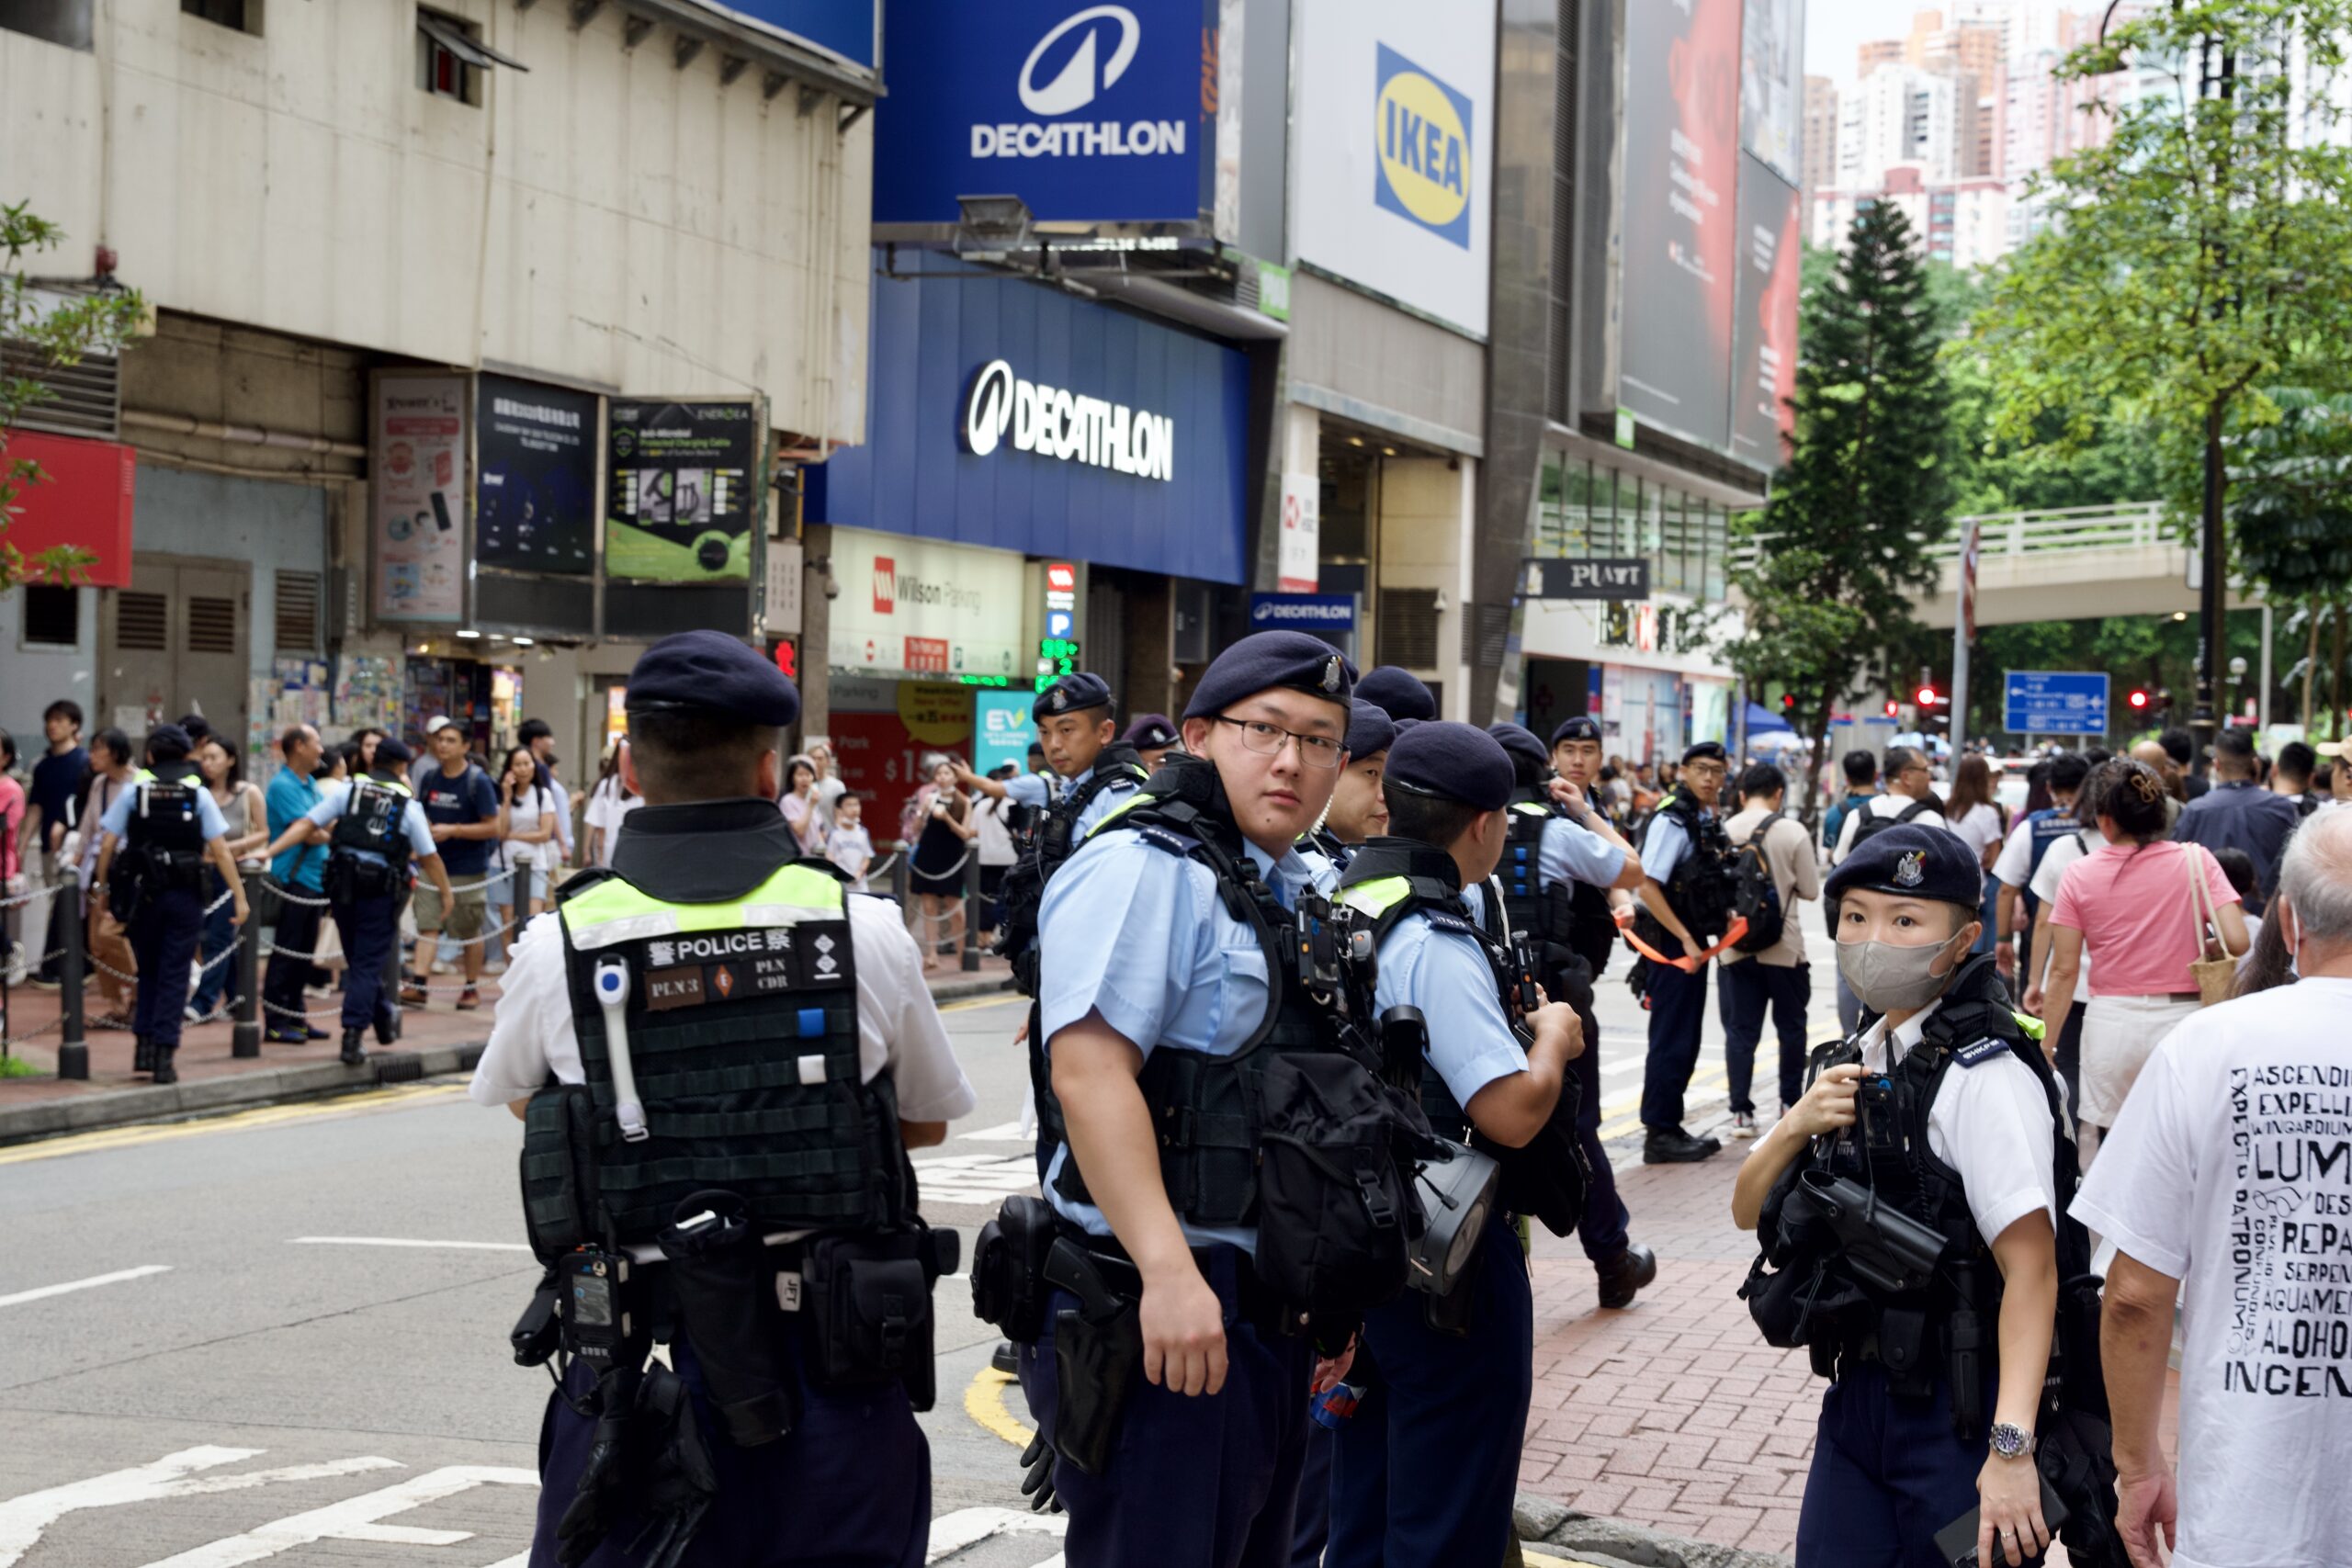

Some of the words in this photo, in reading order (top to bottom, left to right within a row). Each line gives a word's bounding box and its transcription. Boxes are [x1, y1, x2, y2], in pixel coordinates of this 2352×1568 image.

[970, 120, 1185, 158] DECATHLON
[1385, 96, 1464, 198] IKEA
[1013, 378, 1174, 482] DECATHLON
[897, 575, 942, 604] Wilson
[944, 581, 982, 616] Parking
[1051, 614, 1070, 636] P
[1272, 604, 1352, 620] DECATHLON
[1058, 658, 1073, 676] 2
[986, 708, 1025, 732] EV
[677, 931, 763, 960] POLICE
[764, 928, 791, 951] 察
[755, 958, 786, 975] PLN
[757, 974, 788, 990] CDR
[2253, 1066, 2352, 1088] ASCENDI
[2259, 1091, 2352, 1117] EXPELLI
[2231, 1068, 2251, 1179] EXPECTO
[2255, 1138, 2351, 1185] LUM
[2314, 1191, 2352, 1216] DES
[2281, 1221, 2352, 1257] REPA
[2231, 1189, 2253, 1330] PATRONUM
[2284, 1261, 2352, 1284] SERPEN
[2262, 1287, 2352, 1315] AGUAME
[2260, 1318, 2352, 1359] ALOHO
[2223, 1360, 2352, 1398] INCEN
